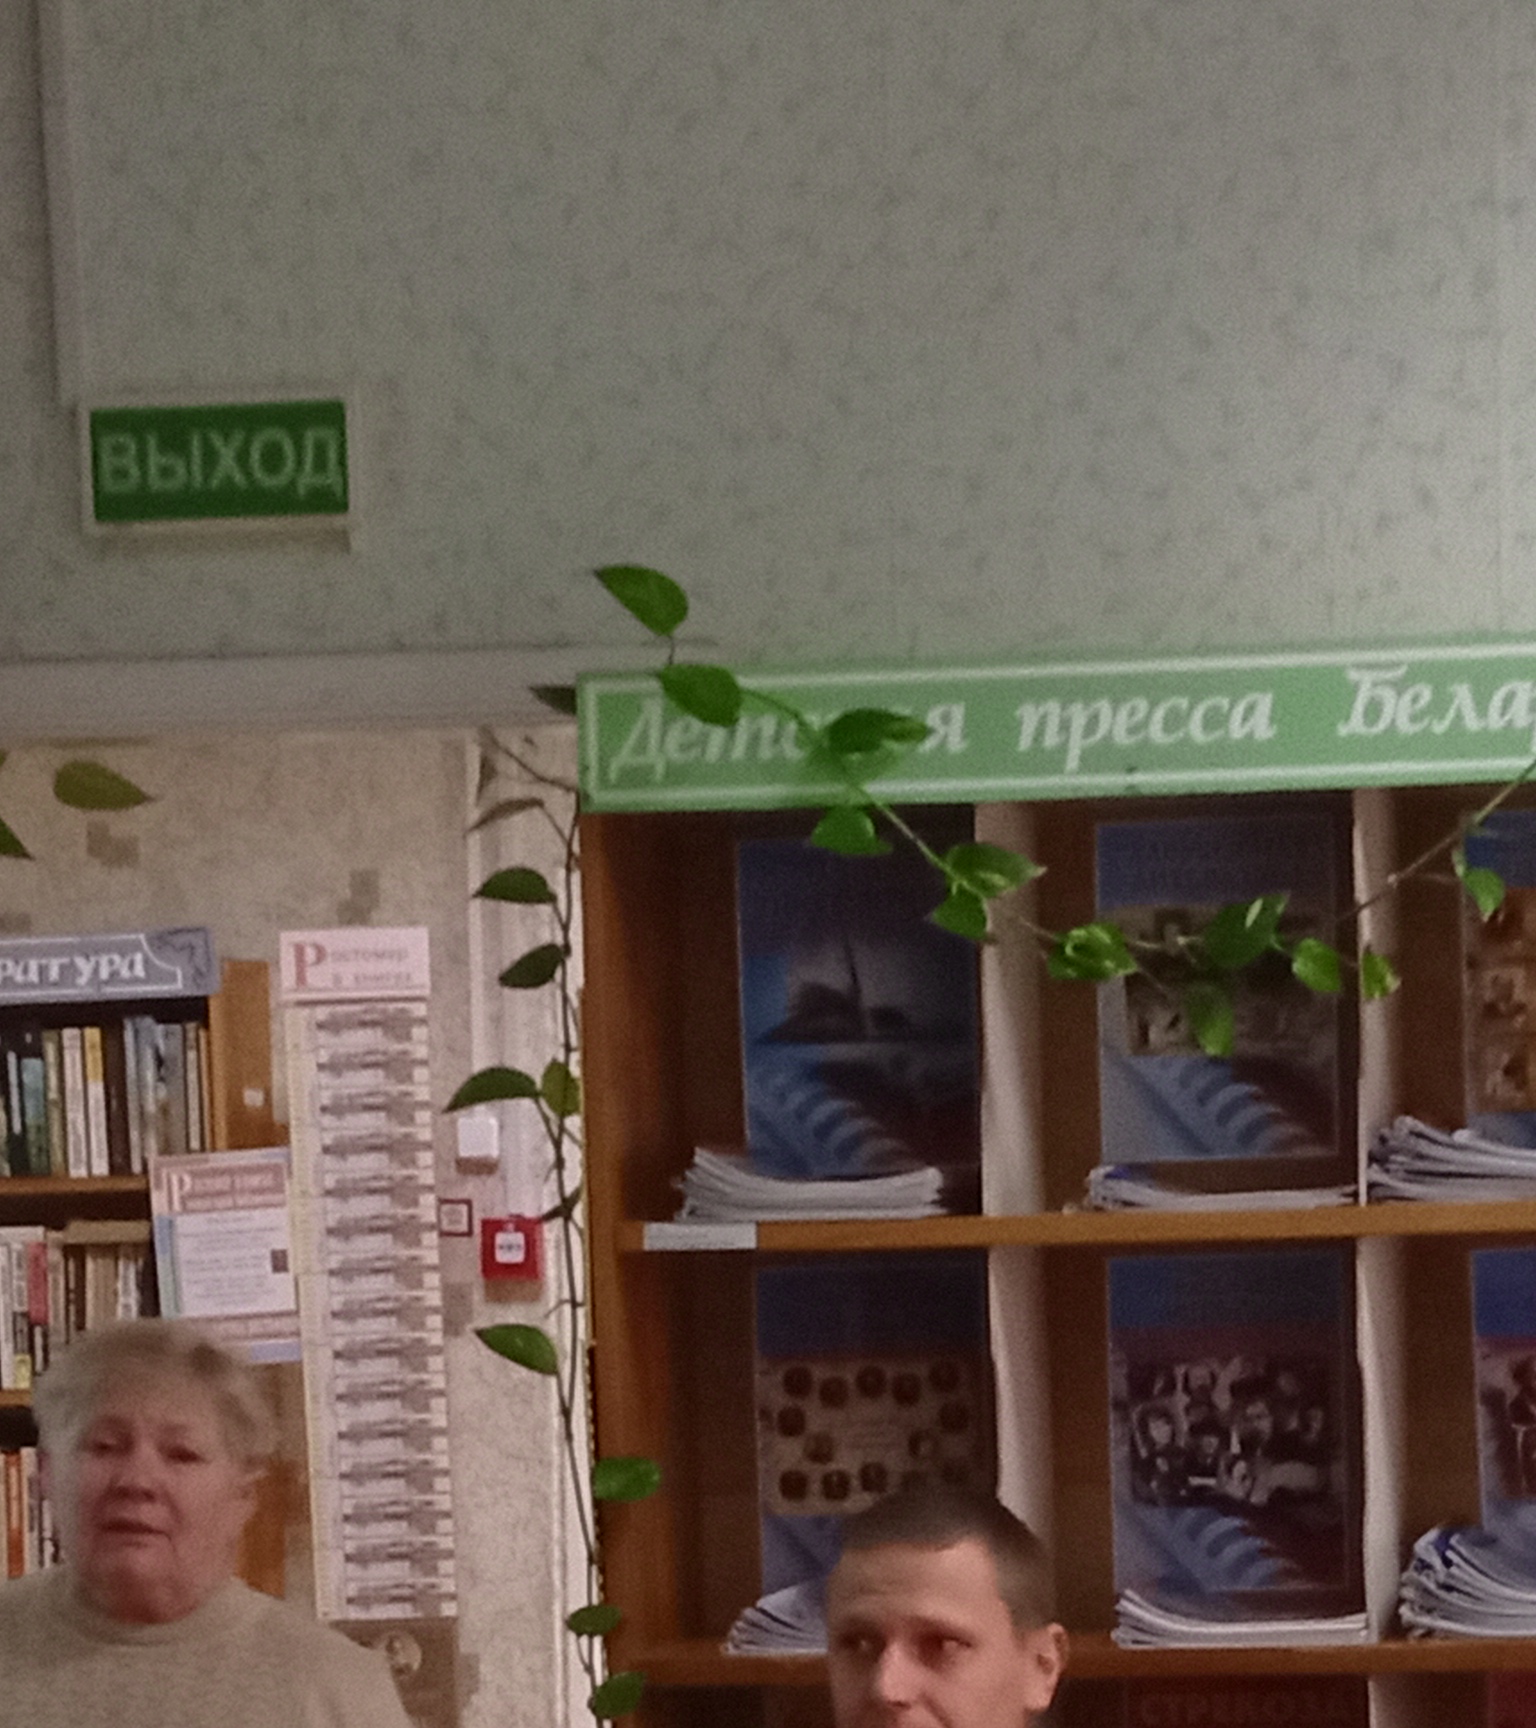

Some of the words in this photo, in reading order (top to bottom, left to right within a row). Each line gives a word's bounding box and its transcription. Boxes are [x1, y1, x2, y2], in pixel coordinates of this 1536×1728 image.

[99, 426, 344, 497] ВЫХОД
[608, 697, 967, 783] Дется
[1014, 692, 1277, 772] пресса
